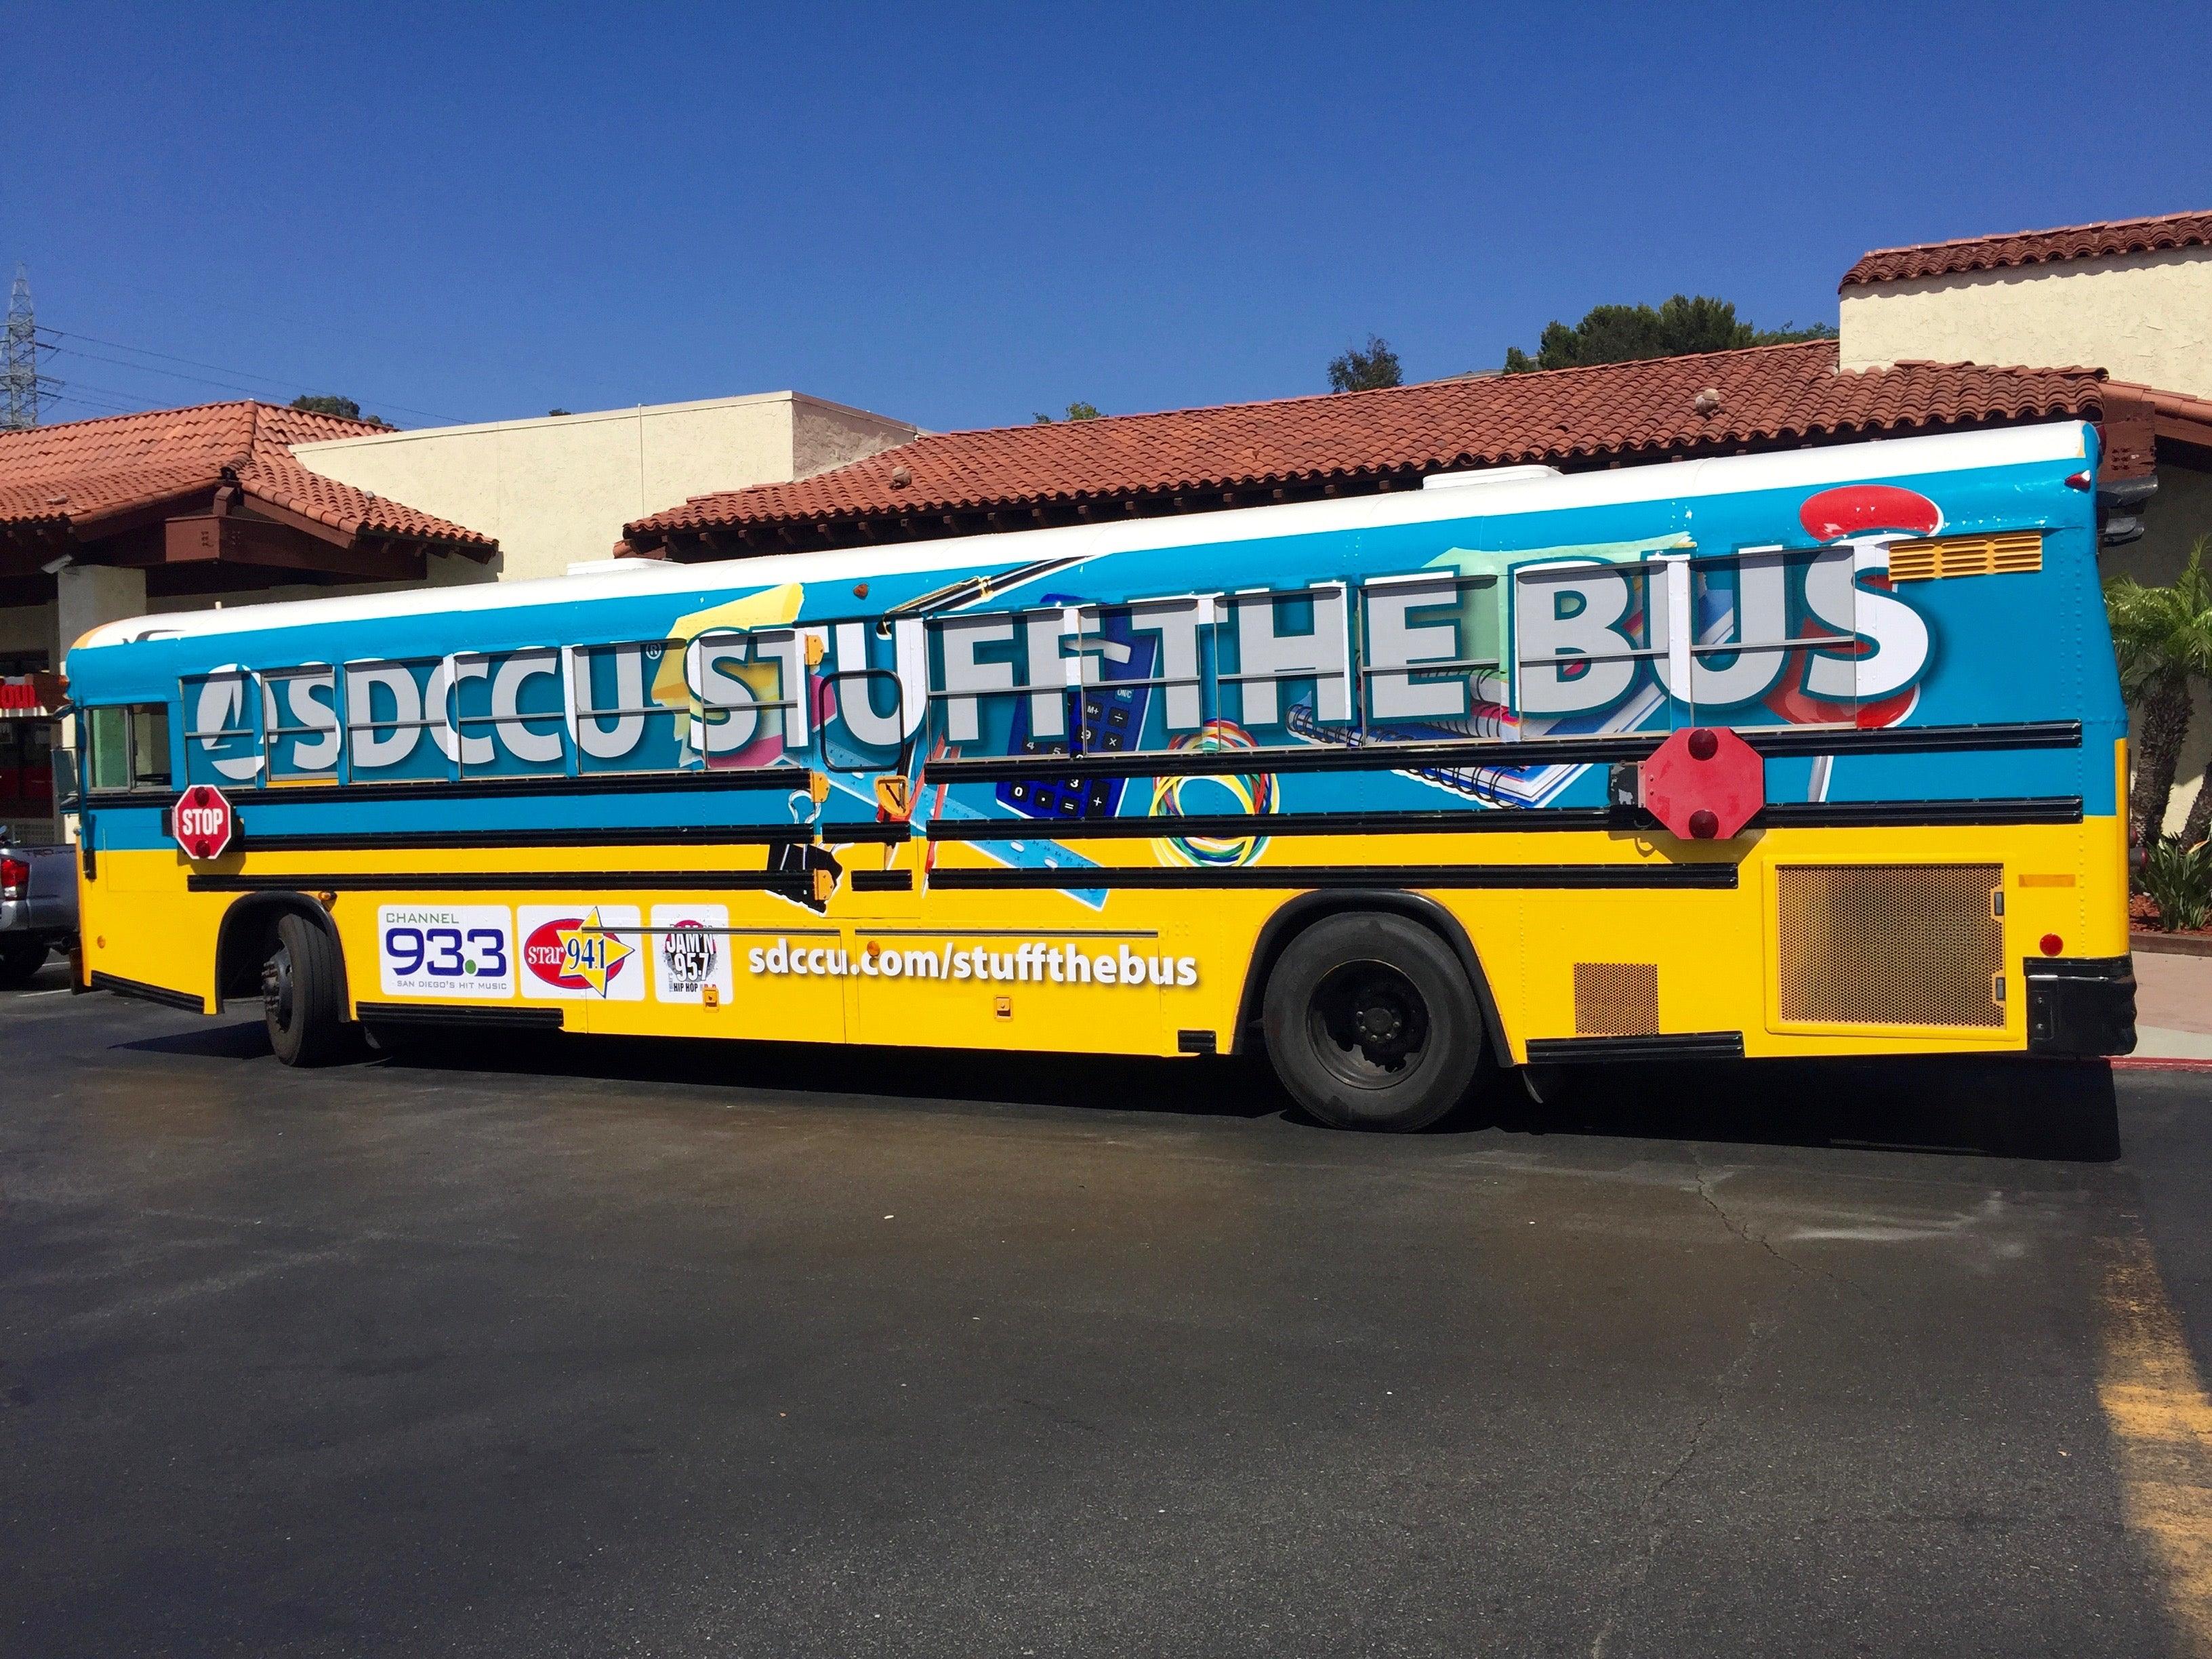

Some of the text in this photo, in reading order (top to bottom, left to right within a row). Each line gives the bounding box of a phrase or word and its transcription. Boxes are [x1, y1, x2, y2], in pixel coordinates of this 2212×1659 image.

[687, 600, 1102, 754] STUFF
[1126, 571, 1467, 731] THE
[1513, 532, 1930, 714] BUS
[182, 808, 223, 835] STOP
[386, 912, 459, 924] CHANNEL
[386, 927, 507, 977] 93.3
[567, 938, 605, 970] 94.1
[666, 933, 714, 954] JAM'N
[674, 952, 709, 981] 95.7
[749, 939, 1197, 986] sdccu.com/stuffthebus
[419, 980, 455, 989] DIEGO'S
[478, 982, 507, 990] MUSIC
[674, 983, 684, 992] HIP
[685, 983, 698, 992] HOP
